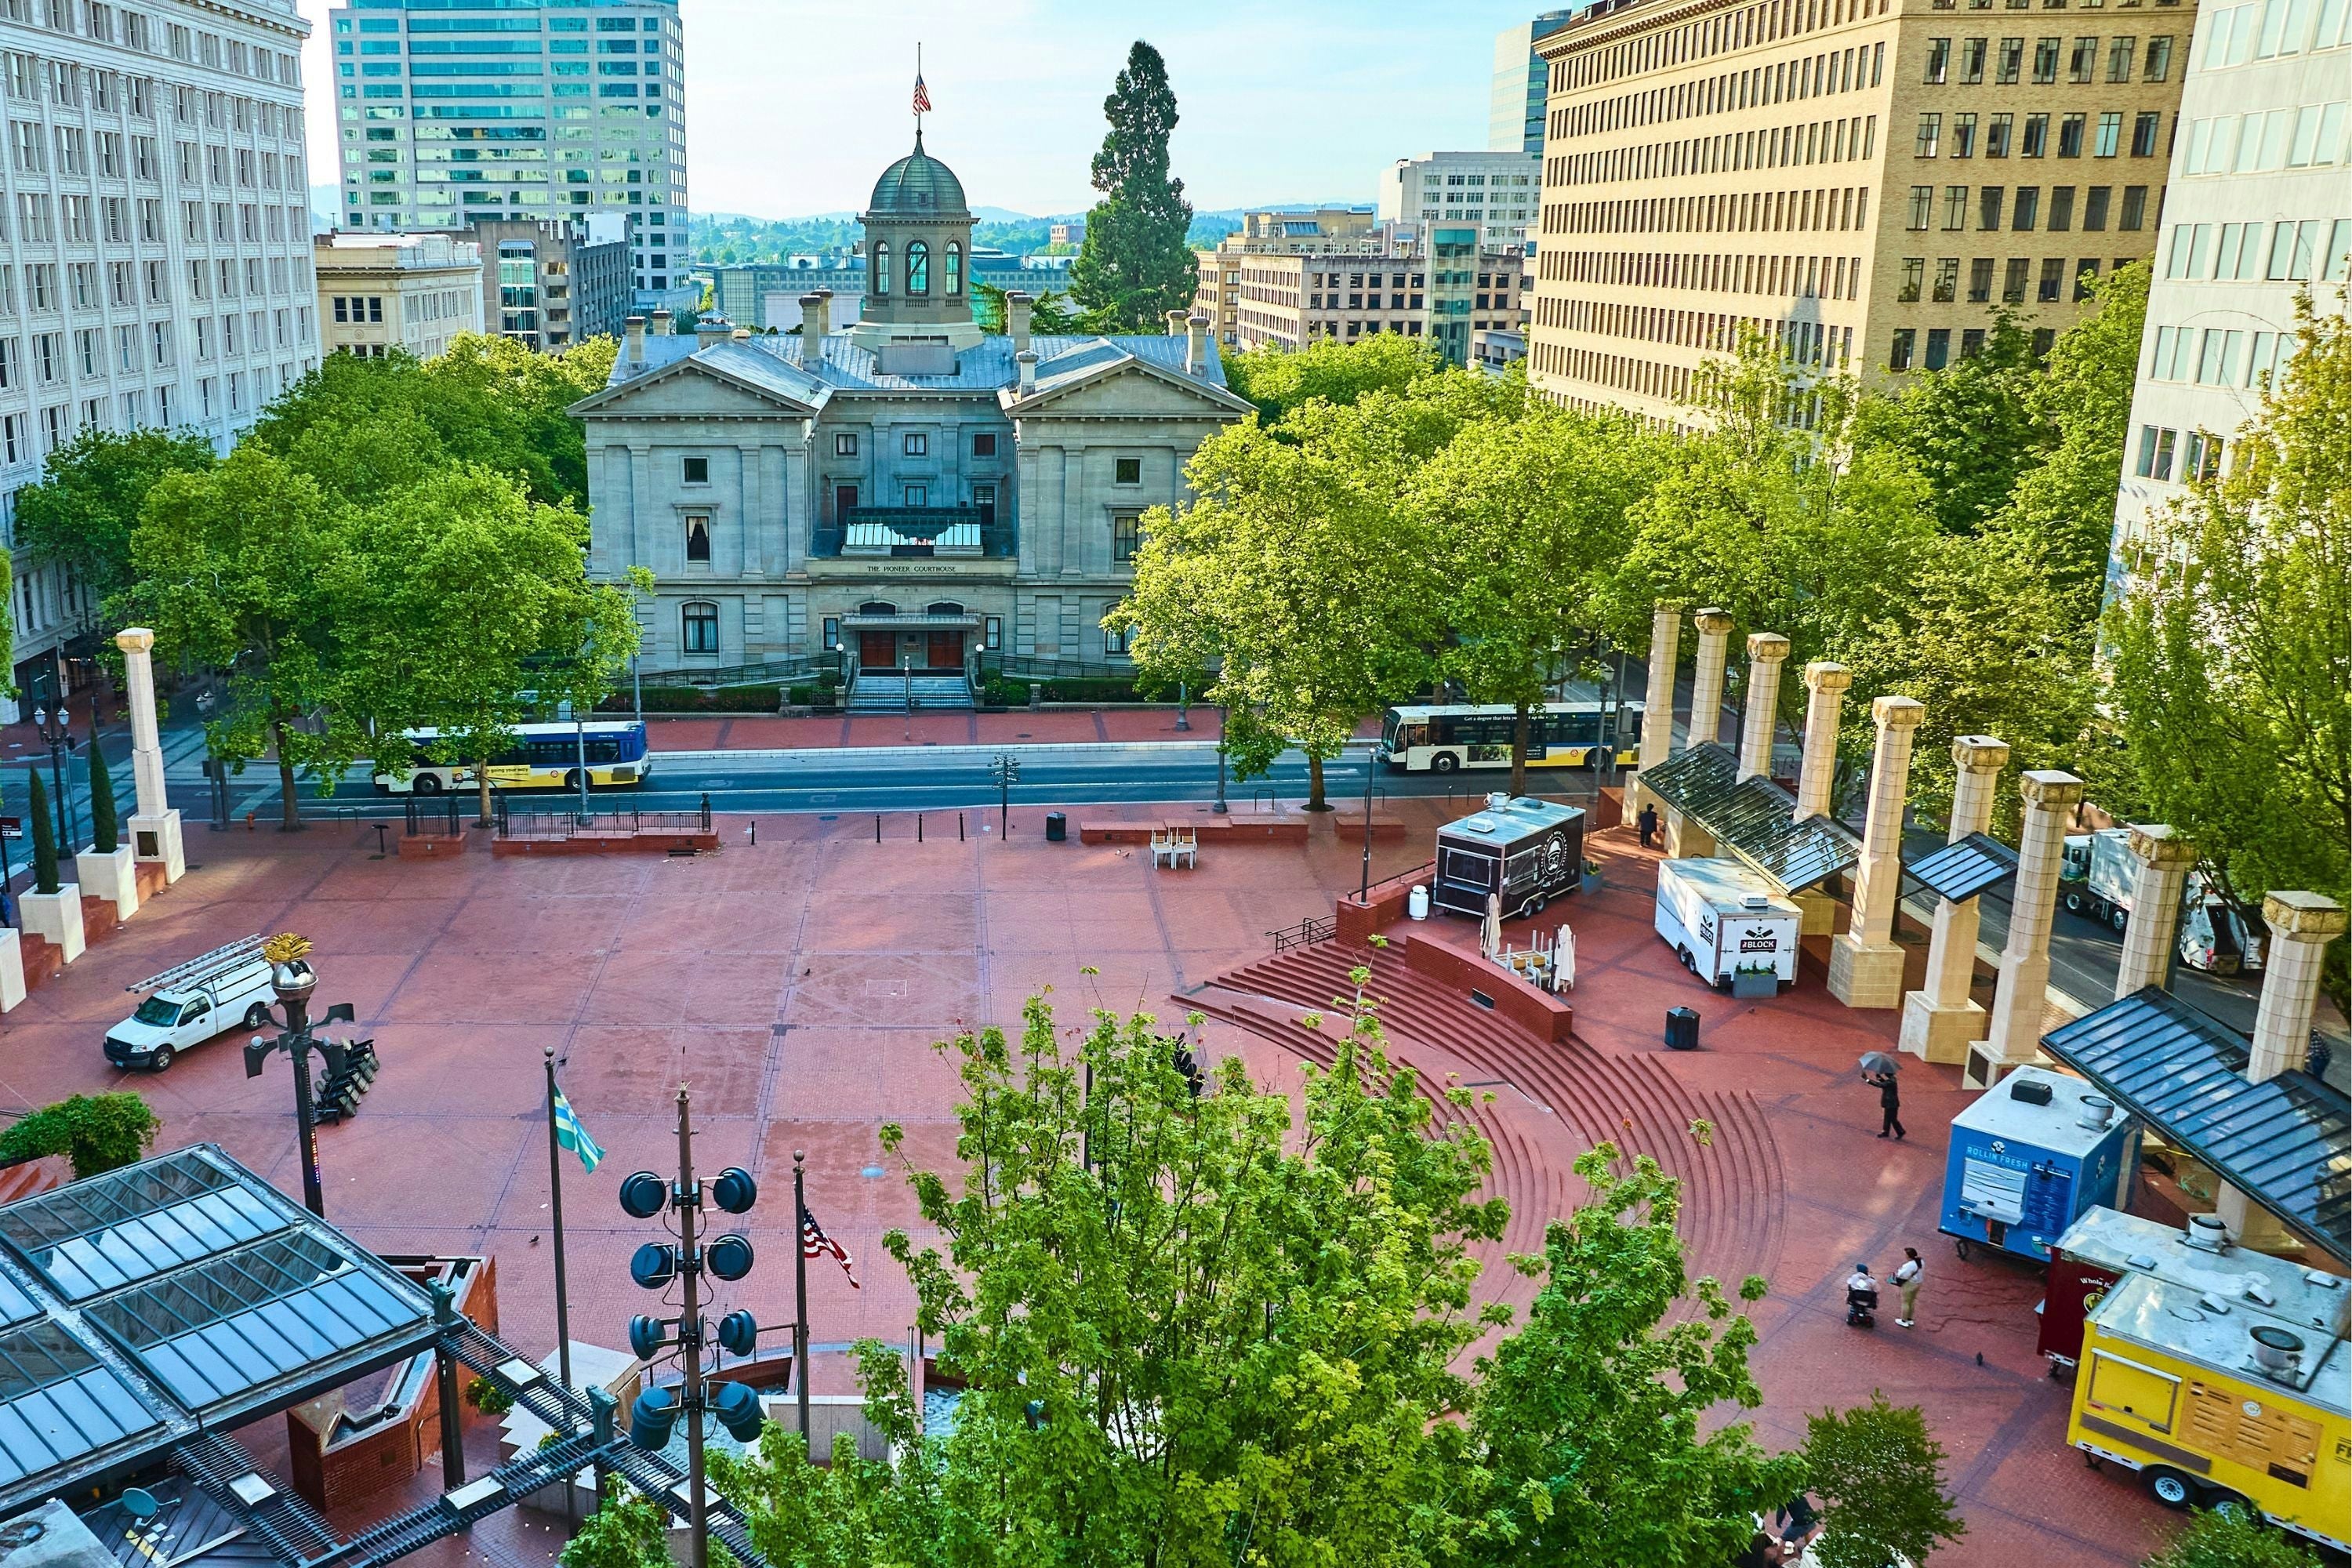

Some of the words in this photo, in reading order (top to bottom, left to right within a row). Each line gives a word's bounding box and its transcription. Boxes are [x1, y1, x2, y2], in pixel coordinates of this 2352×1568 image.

[1747, 940, 1775, 949] BLOCK
[1966, 1146, 1998, 1161] ROLLIN
[2000, 1155, 2028, 1170] FRESH
[2079, 1277, 2103, 1286] Whole
